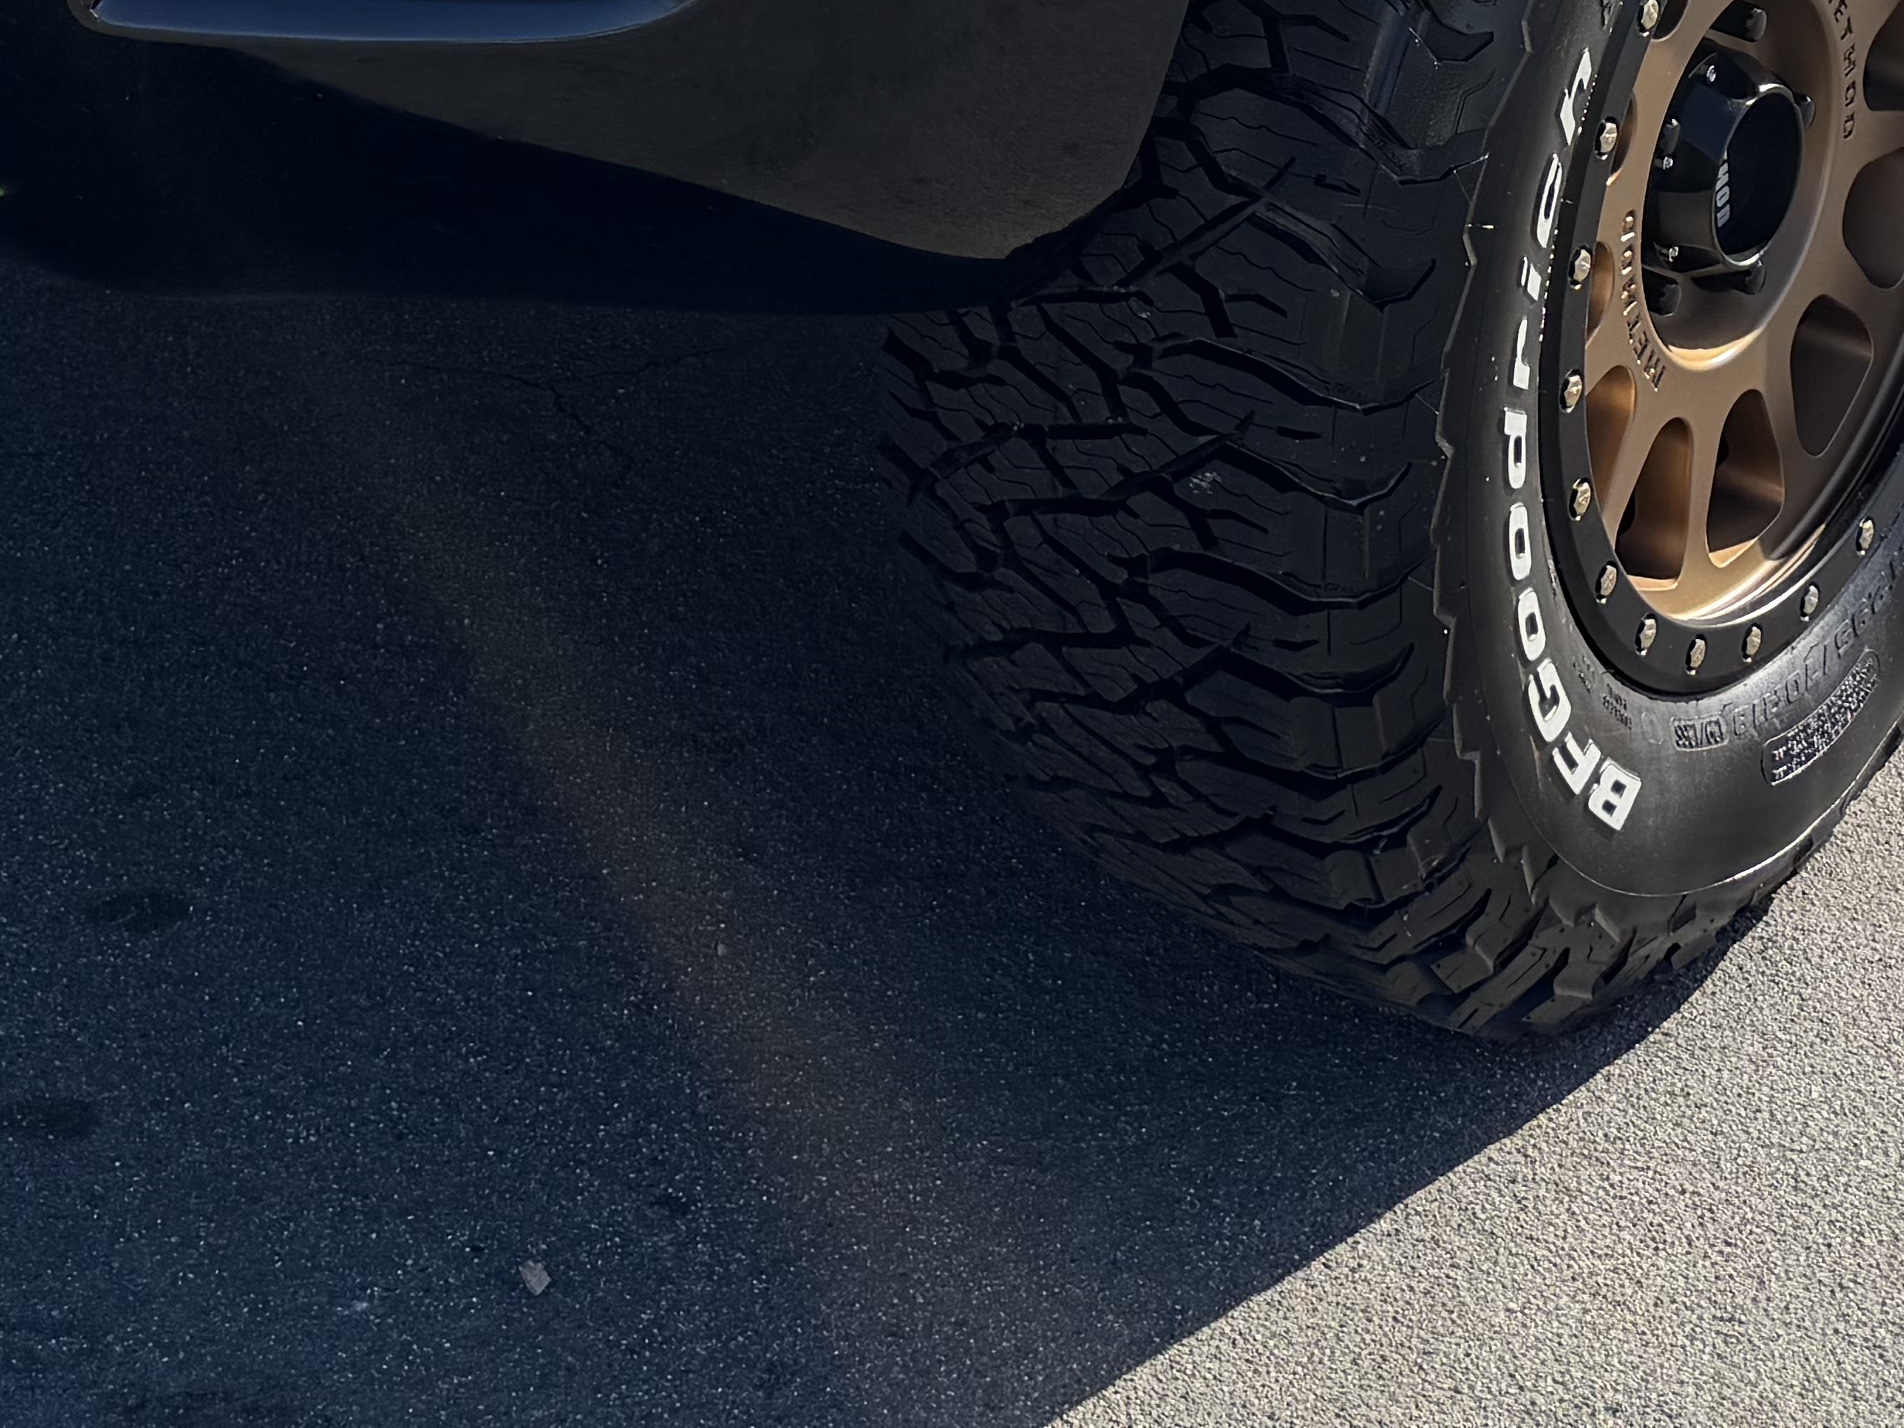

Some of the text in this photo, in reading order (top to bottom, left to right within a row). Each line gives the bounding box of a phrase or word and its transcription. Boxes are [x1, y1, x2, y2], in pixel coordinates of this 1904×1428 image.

[1714, 161, 1731, 228] HOD
[1620, 209, 1667, 392] METHOD
[1501, 47, 1642, 832] BFGoodrich
